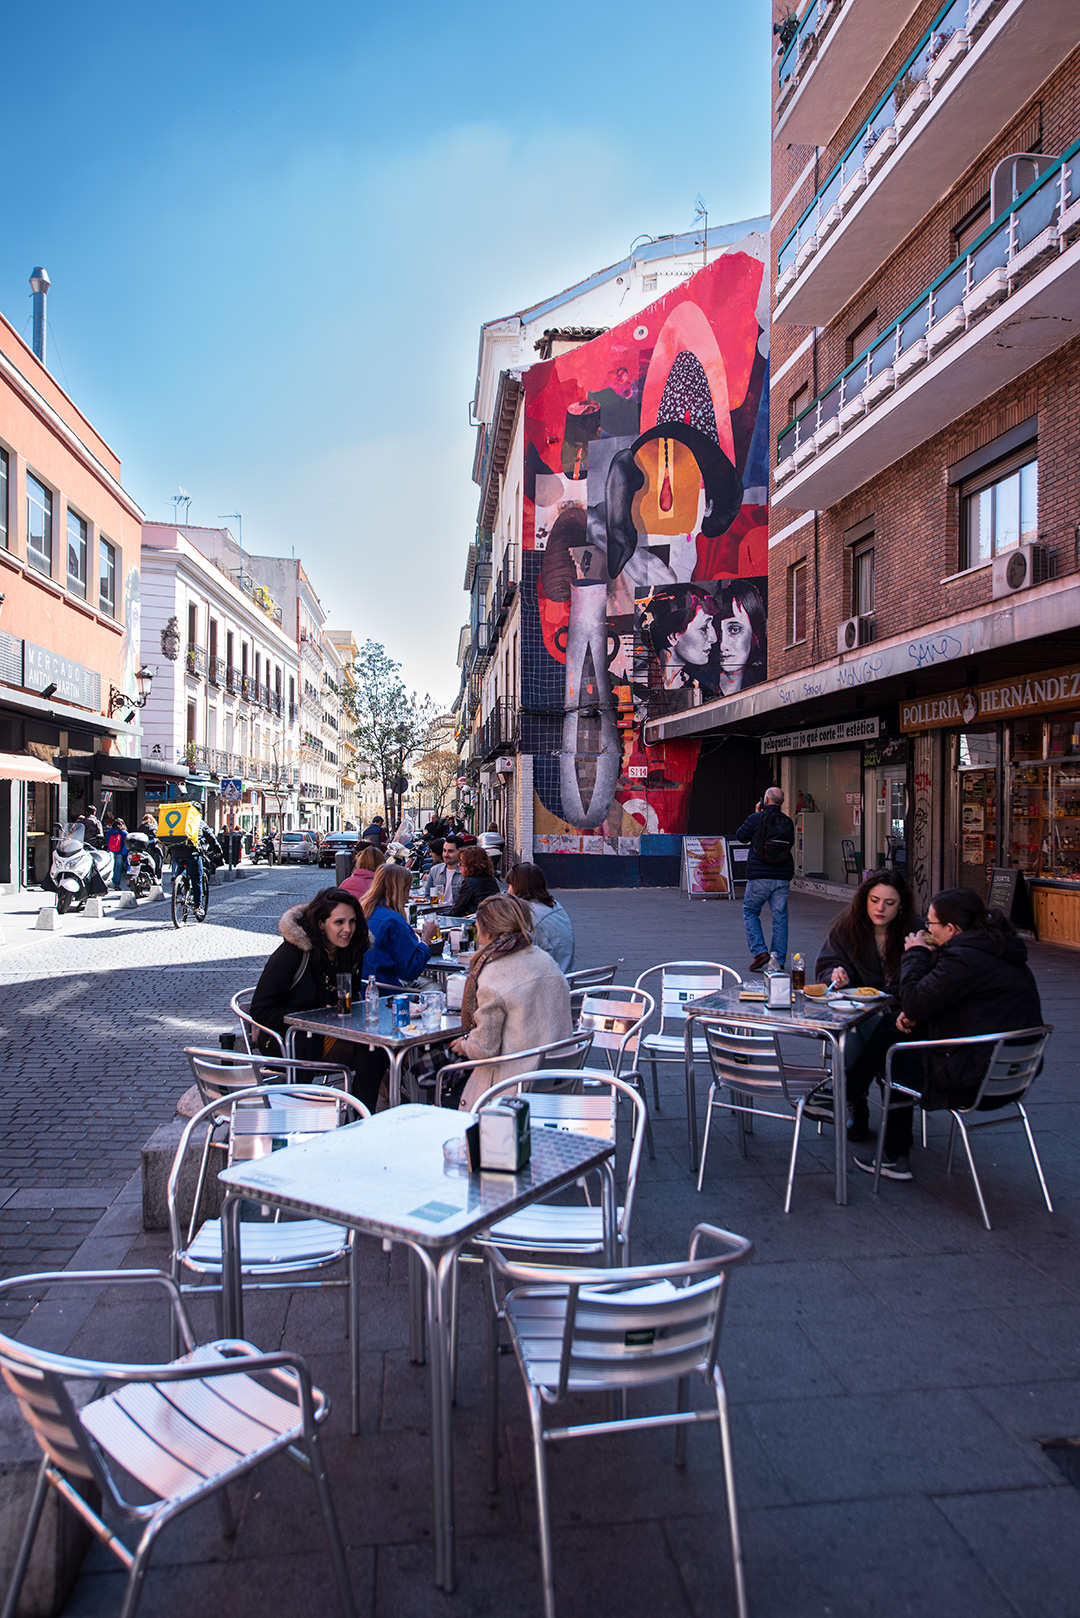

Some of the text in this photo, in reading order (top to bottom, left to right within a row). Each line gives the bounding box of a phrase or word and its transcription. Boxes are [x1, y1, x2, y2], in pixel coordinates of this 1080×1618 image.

[28, 647, 80, 682] MERCADO
[56, 677, 80, 699] MARTIN
[903, 673, 1080, 725] POLLERÍA HERNÁNDEZ
[763, 734, 792, 753] peluquería
[799, 732, 806, 747] jo
[806, 729, 818, 747] qué
[819, 727, 836, 742] corte
[846, 721, 875, 737] estética
